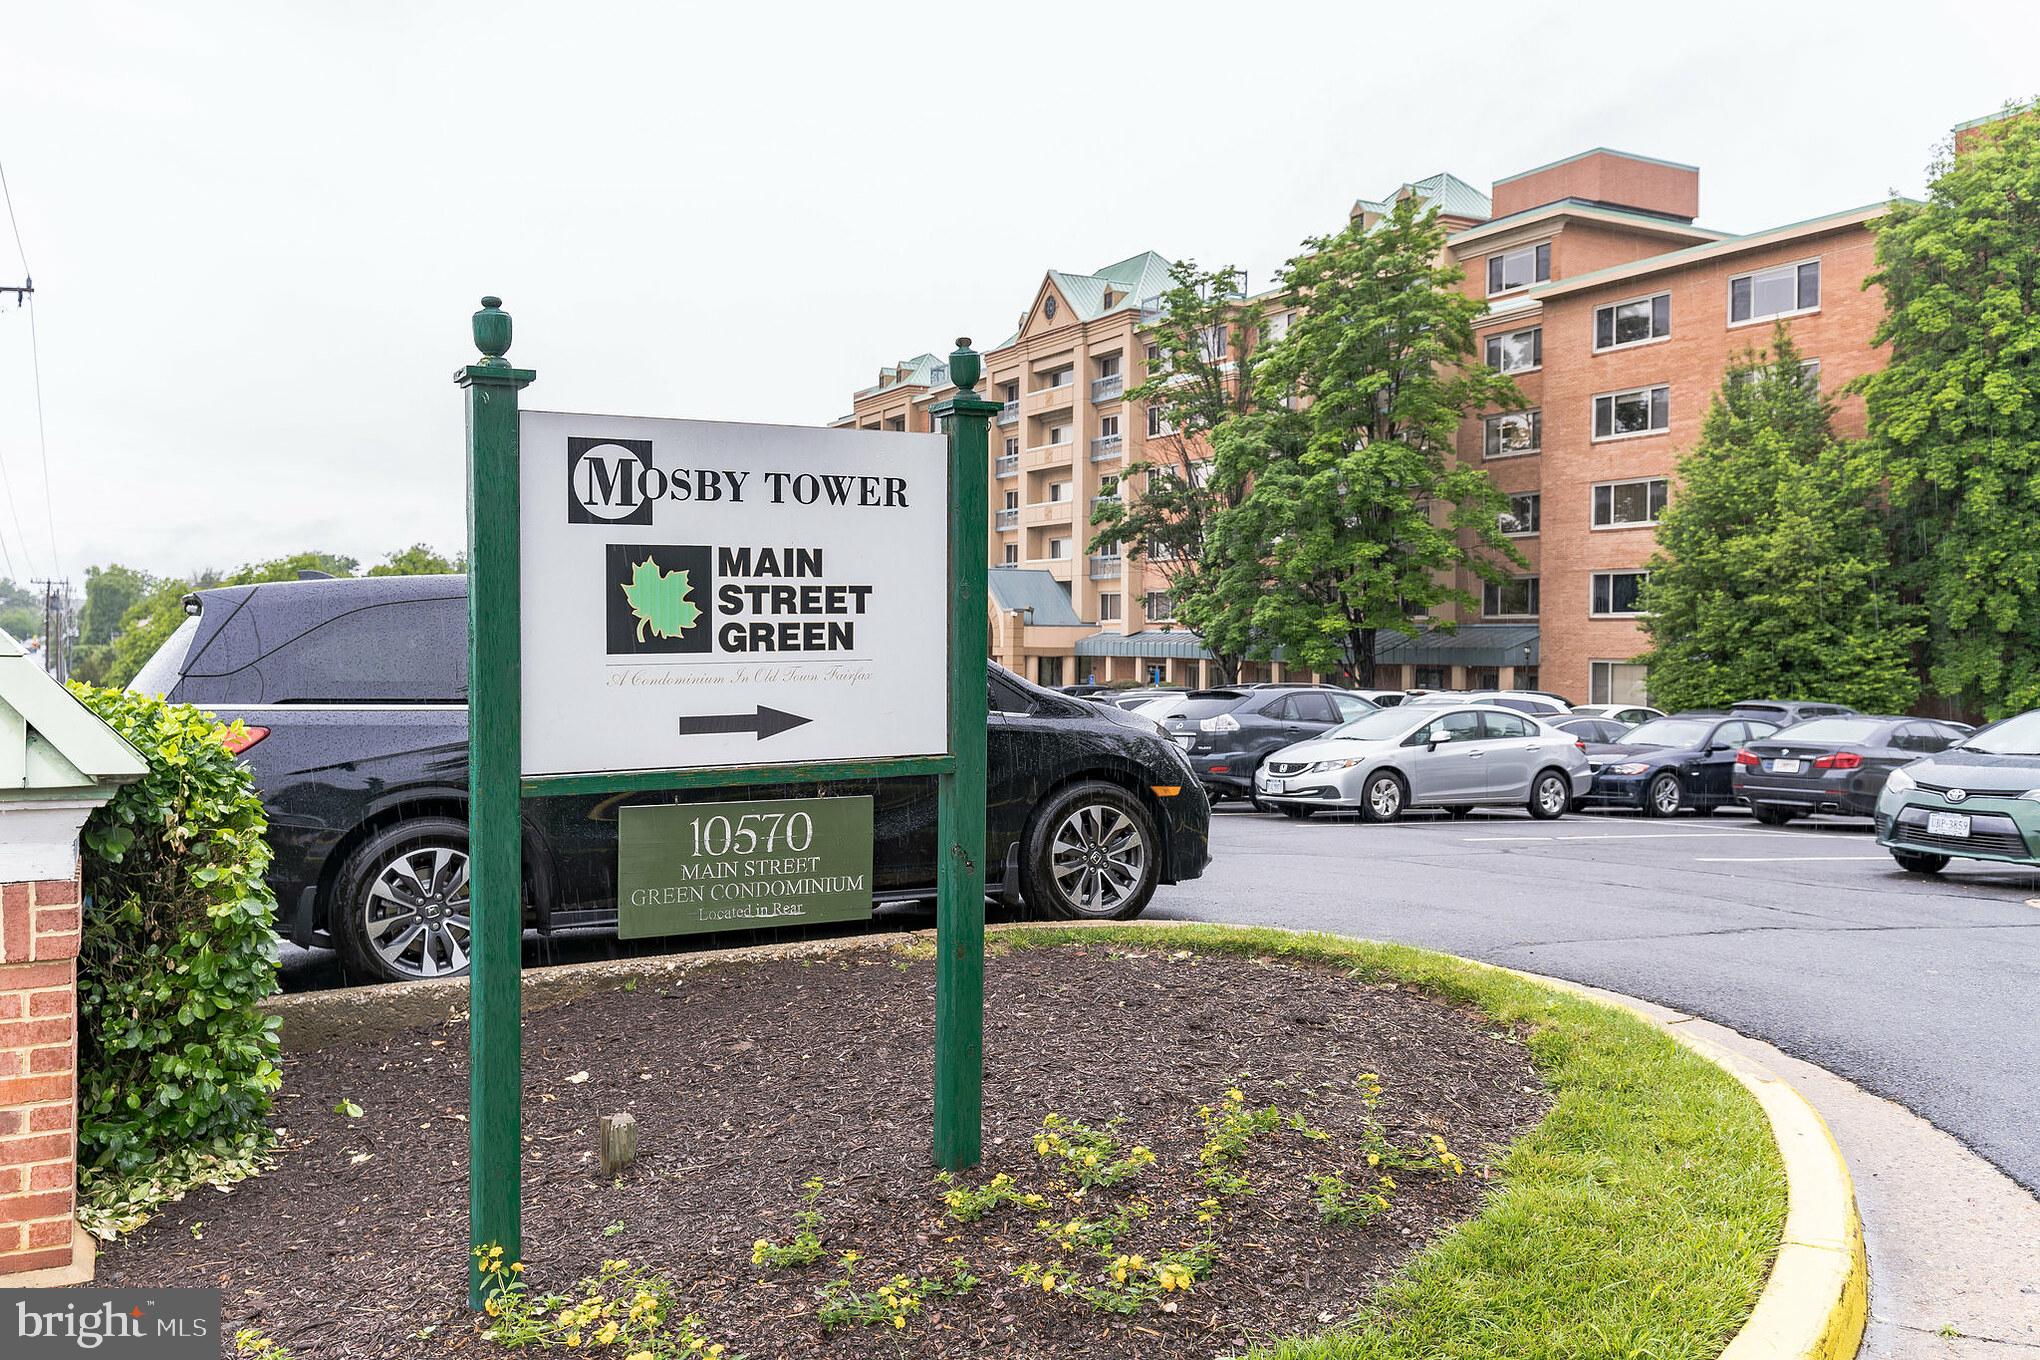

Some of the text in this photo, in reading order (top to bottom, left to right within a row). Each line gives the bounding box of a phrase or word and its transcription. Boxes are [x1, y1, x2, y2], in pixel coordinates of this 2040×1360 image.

[583, 456, 909, 508] MOSBY TOWER
[718, 547, 823, 578] MAIN
[717, 585, 873, 616] STREET
[717, 622, 854, 653] GREEN
[606, 665, 873, 687] A Condominium In Old Town Fairfax
[690, 811, 813, 857] 10570
[680, 856, 820, 881] MAIN STREET
[631, 874, 864, 906] GREEN CONDOMINIUM
[699, 902, 803, 921] Located in Rear
